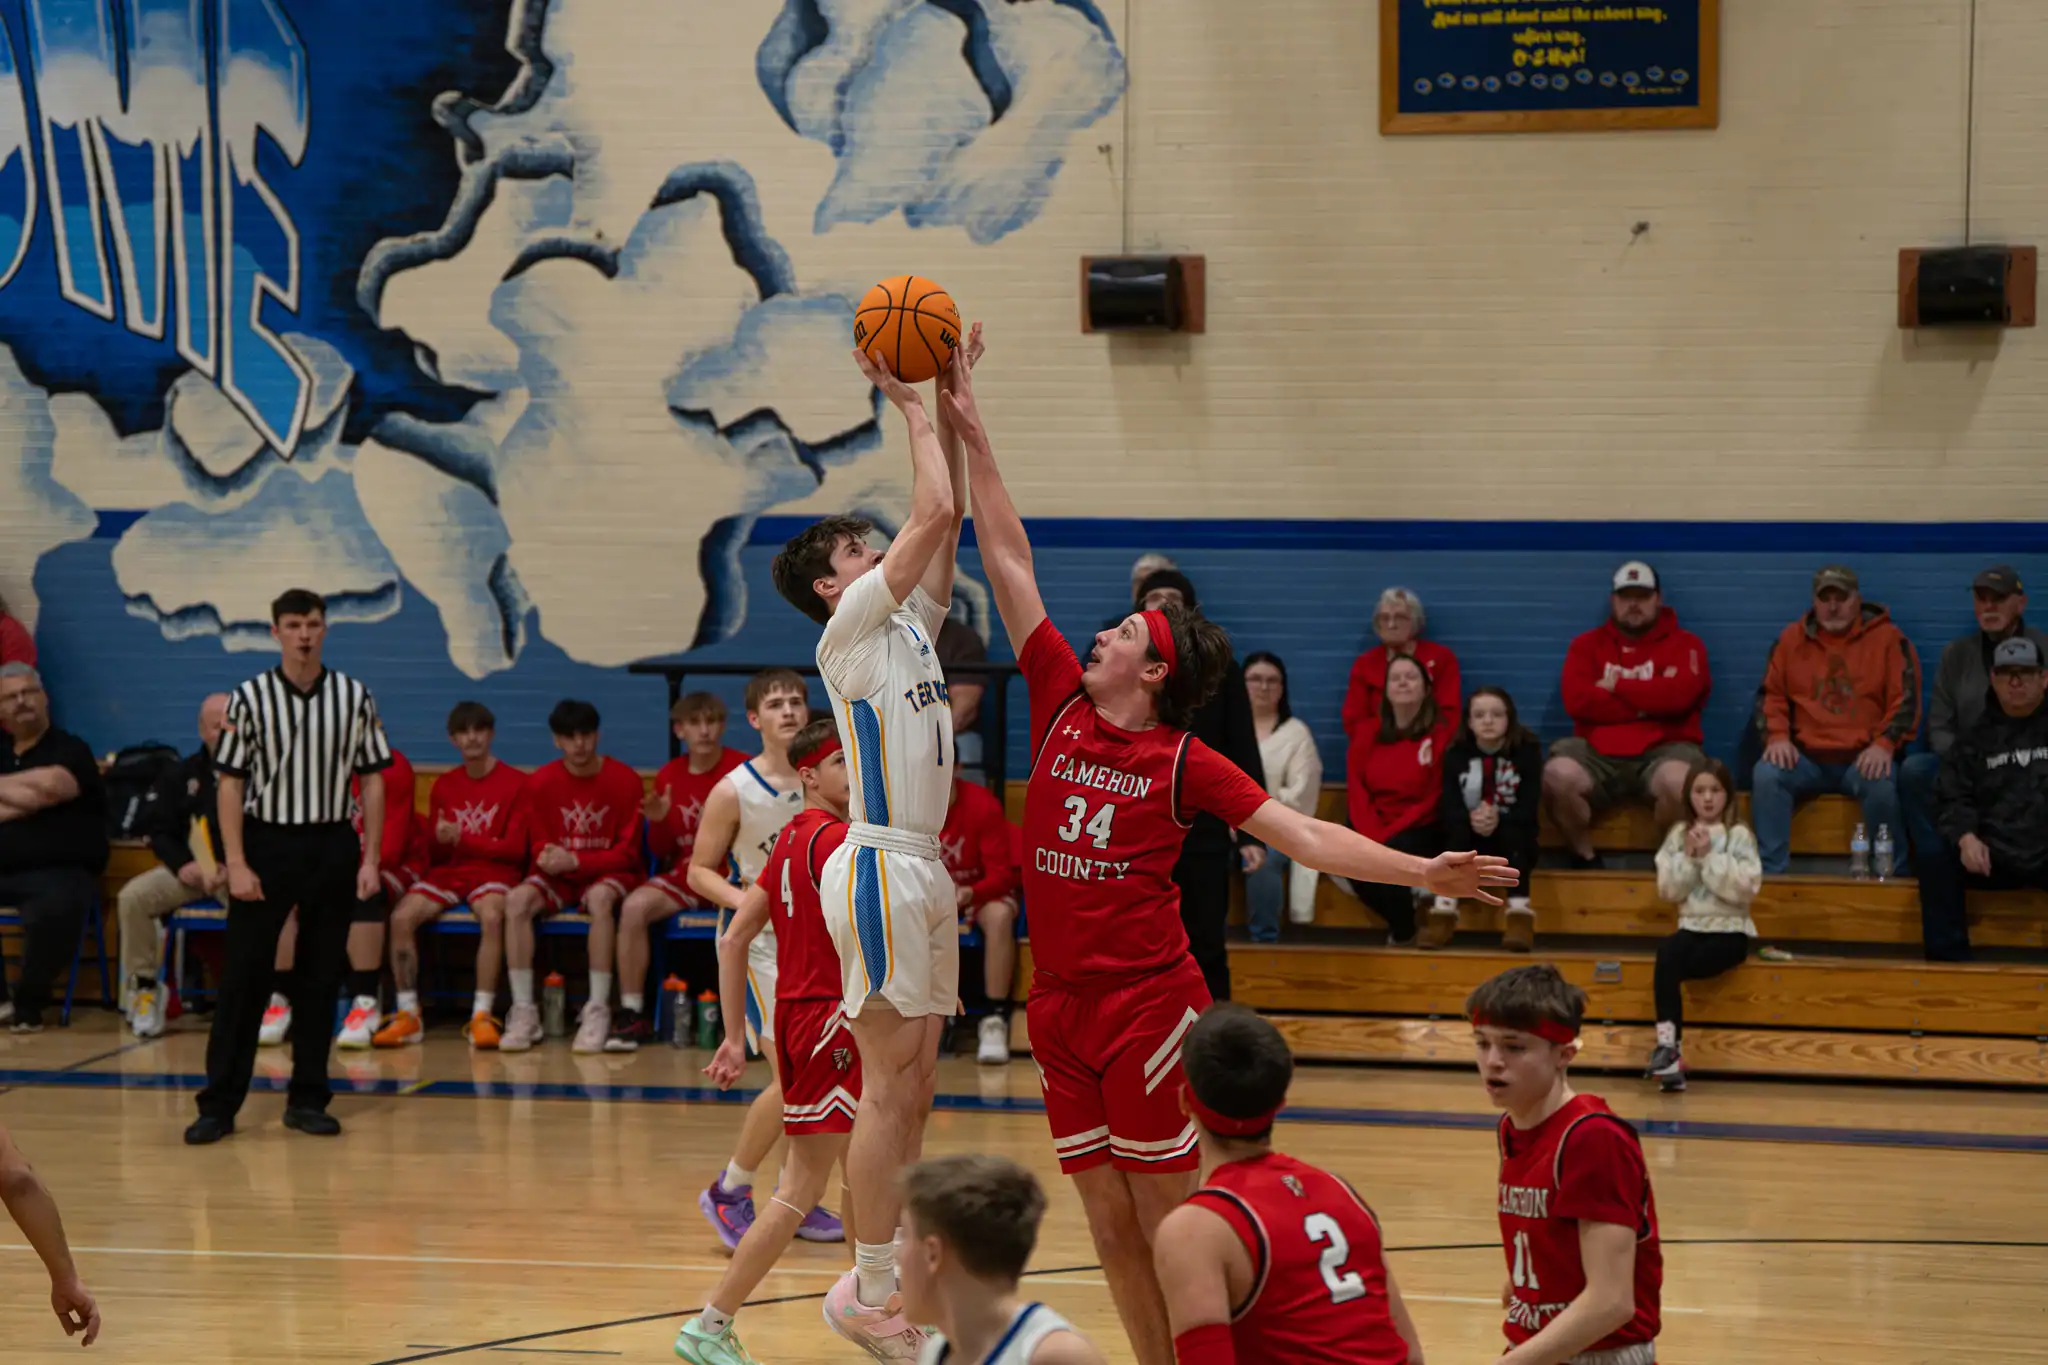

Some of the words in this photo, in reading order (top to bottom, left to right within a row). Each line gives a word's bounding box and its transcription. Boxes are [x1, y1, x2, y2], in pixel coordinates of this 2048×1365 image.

[1050, 753, 1153, 799] CAMERON
[1058, 794, 1116, 849] 34
[781, 857, 794, 918] 4
[1035, 847, 1130, 880] COUNTY
[1304, 1211, 1366, 1304] 2
[1513, 1230, 1540, 1290] 11
